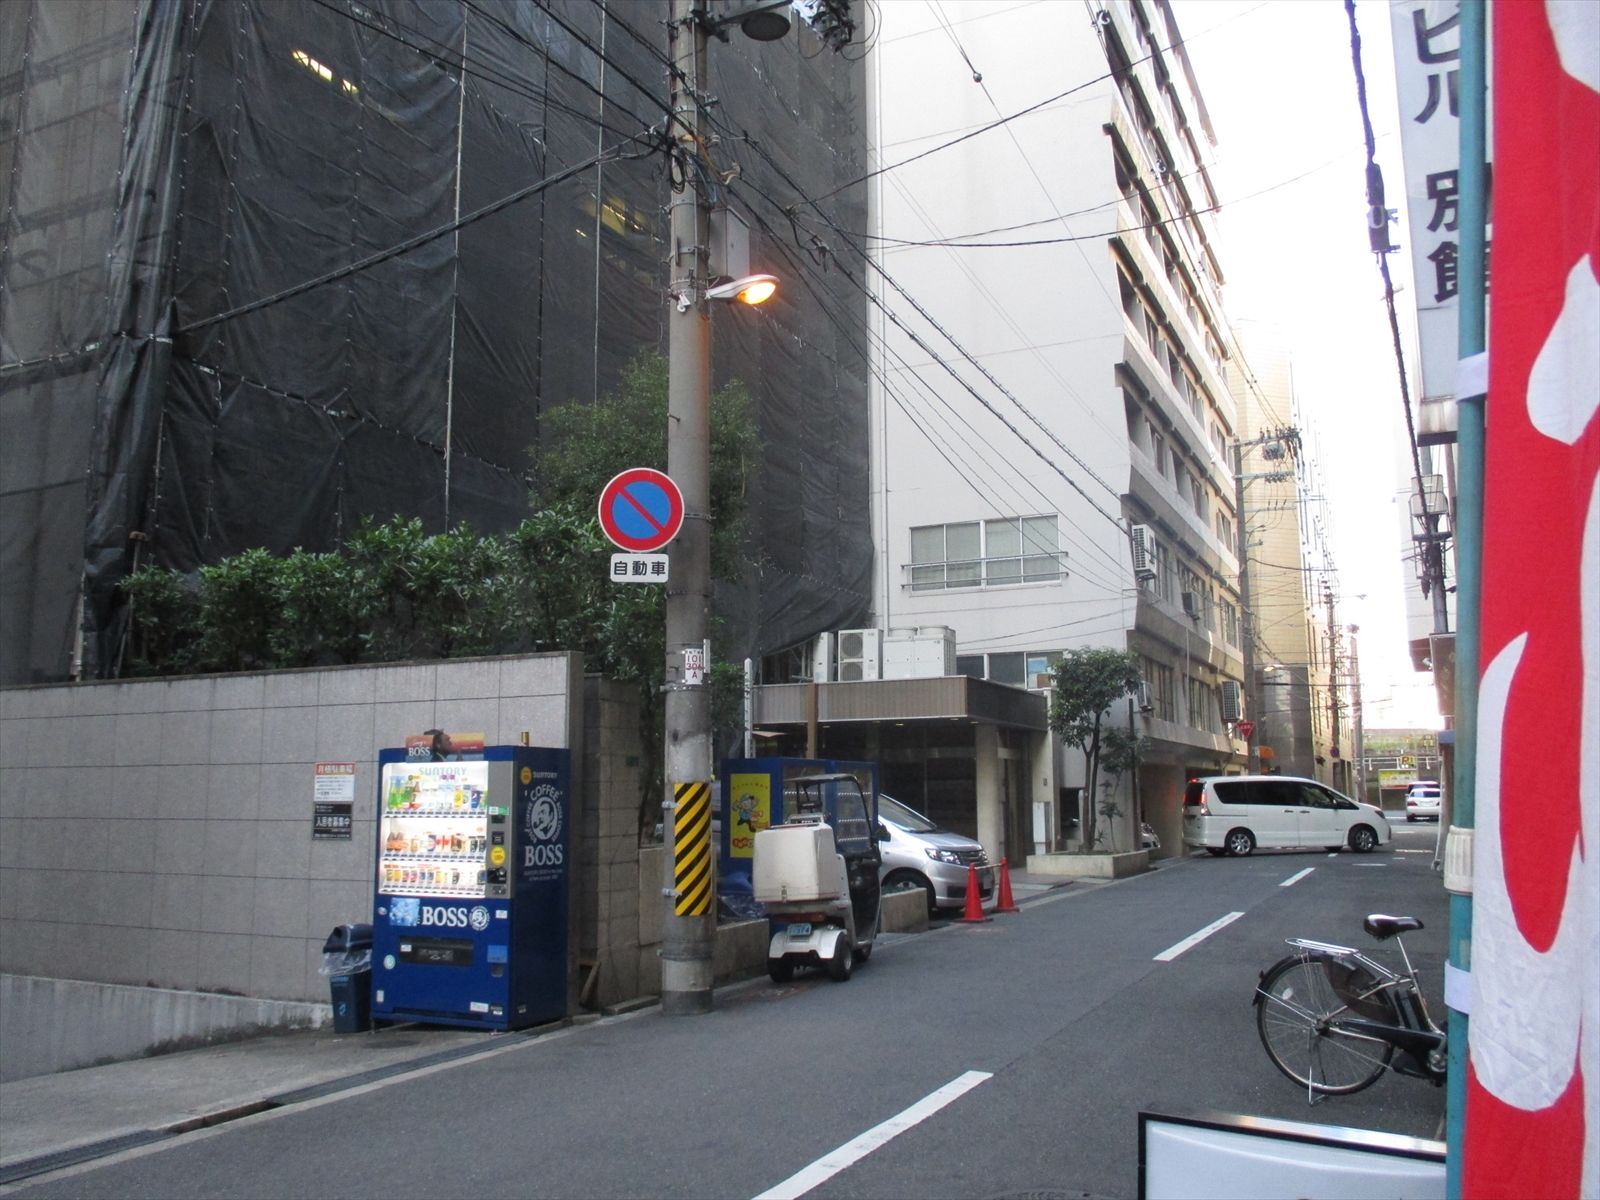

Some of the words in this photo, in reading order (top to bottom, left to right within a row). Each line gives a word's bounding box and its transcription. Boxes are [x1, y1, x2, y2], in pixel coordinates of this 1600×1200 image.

[613, 560, 666, 576] 自動車
[687, 655, 703, 663] 101
[692, 671, 697, 679] A
[408, 746, 431, 757] BOSS
[418, 767, 467, 776] SUNTORY
[533, 771, 558, 779] SUNTORY
[530, 784, 560, 801] COFFEE
[524, 844, 563, 867] BOSS
[421, 906, 468, 928] BOSS
